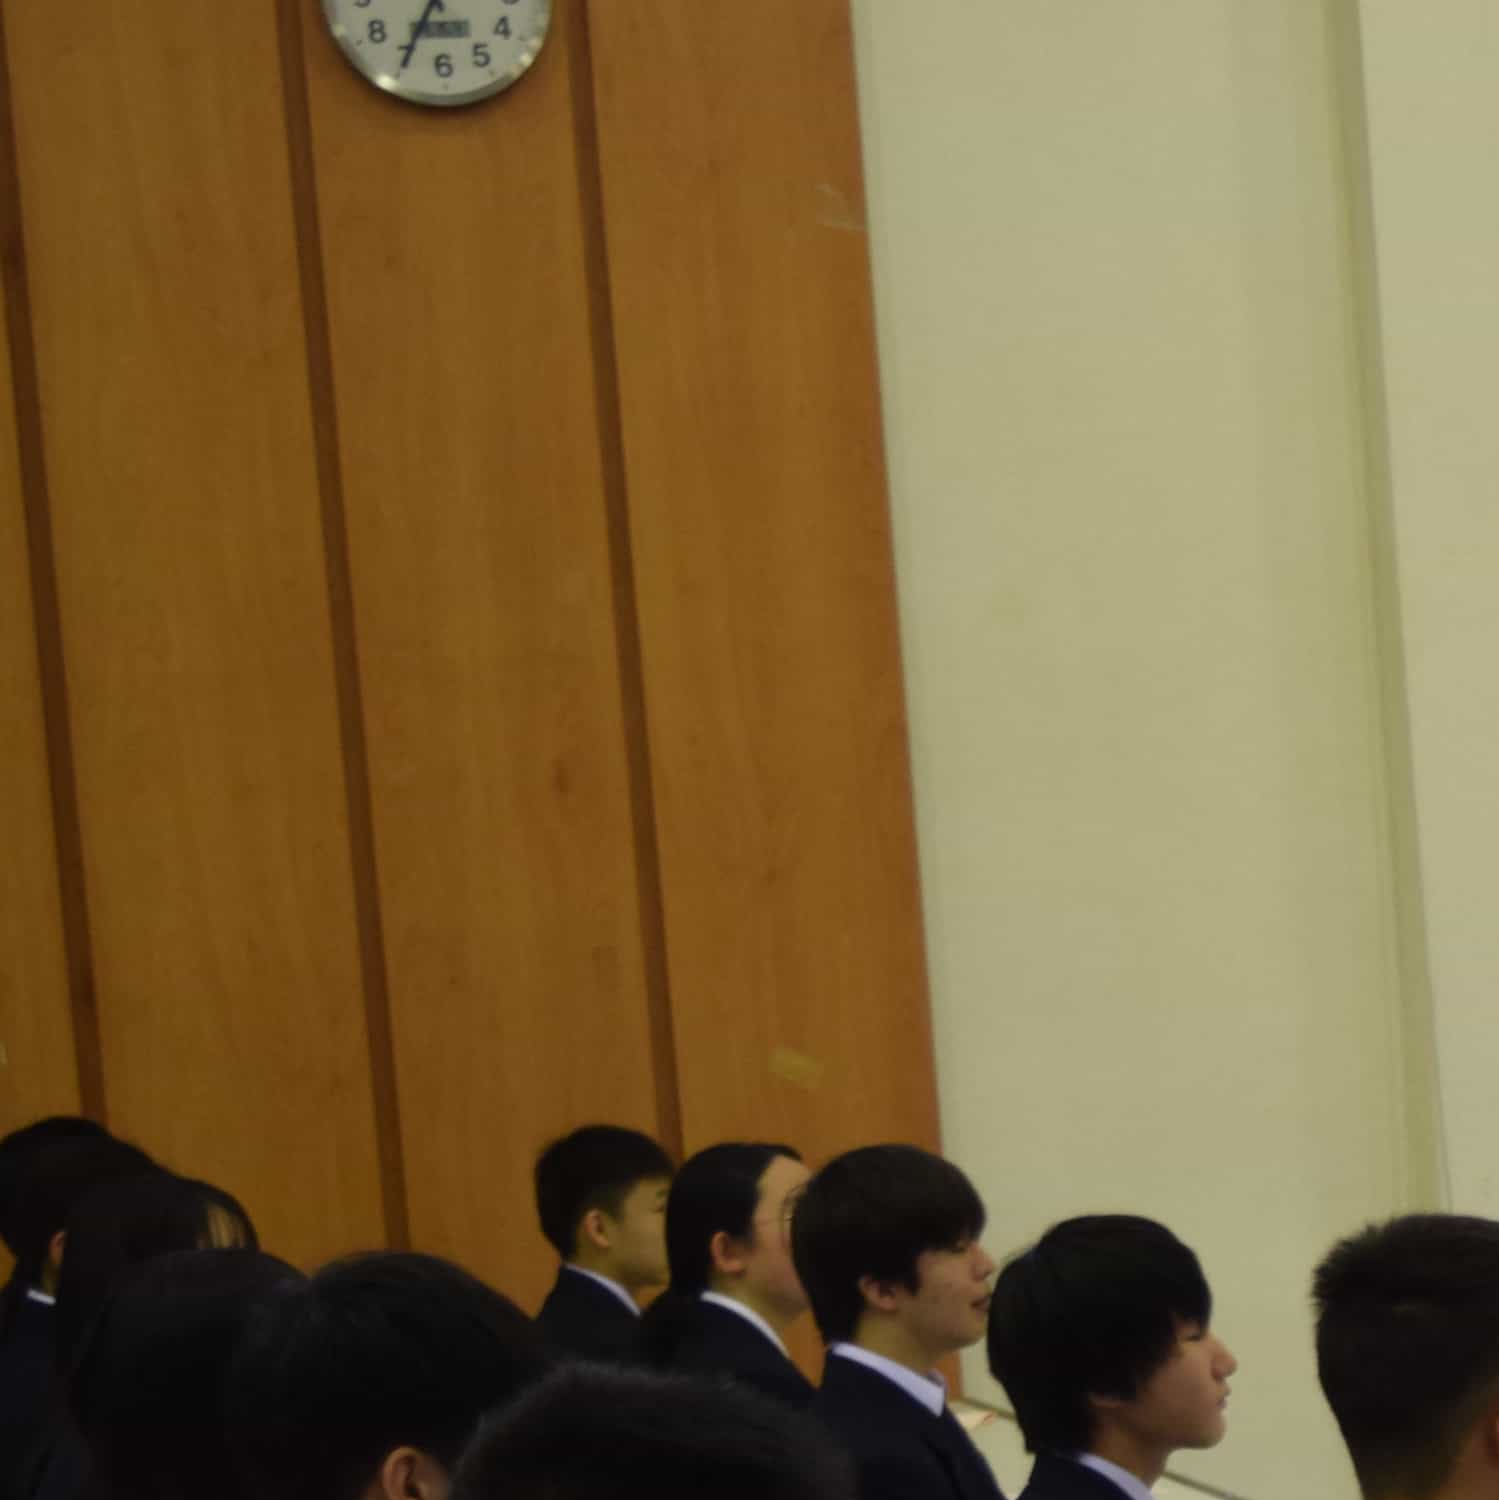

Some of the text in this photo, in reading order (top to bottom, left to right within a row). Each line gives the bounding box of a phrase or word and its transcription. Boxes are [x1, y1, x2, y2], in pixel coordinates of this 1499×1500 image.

[367, 19, 387, 44] 8
[433, 52, 454, 78] 6
[471, 43, 491, 68] 5
